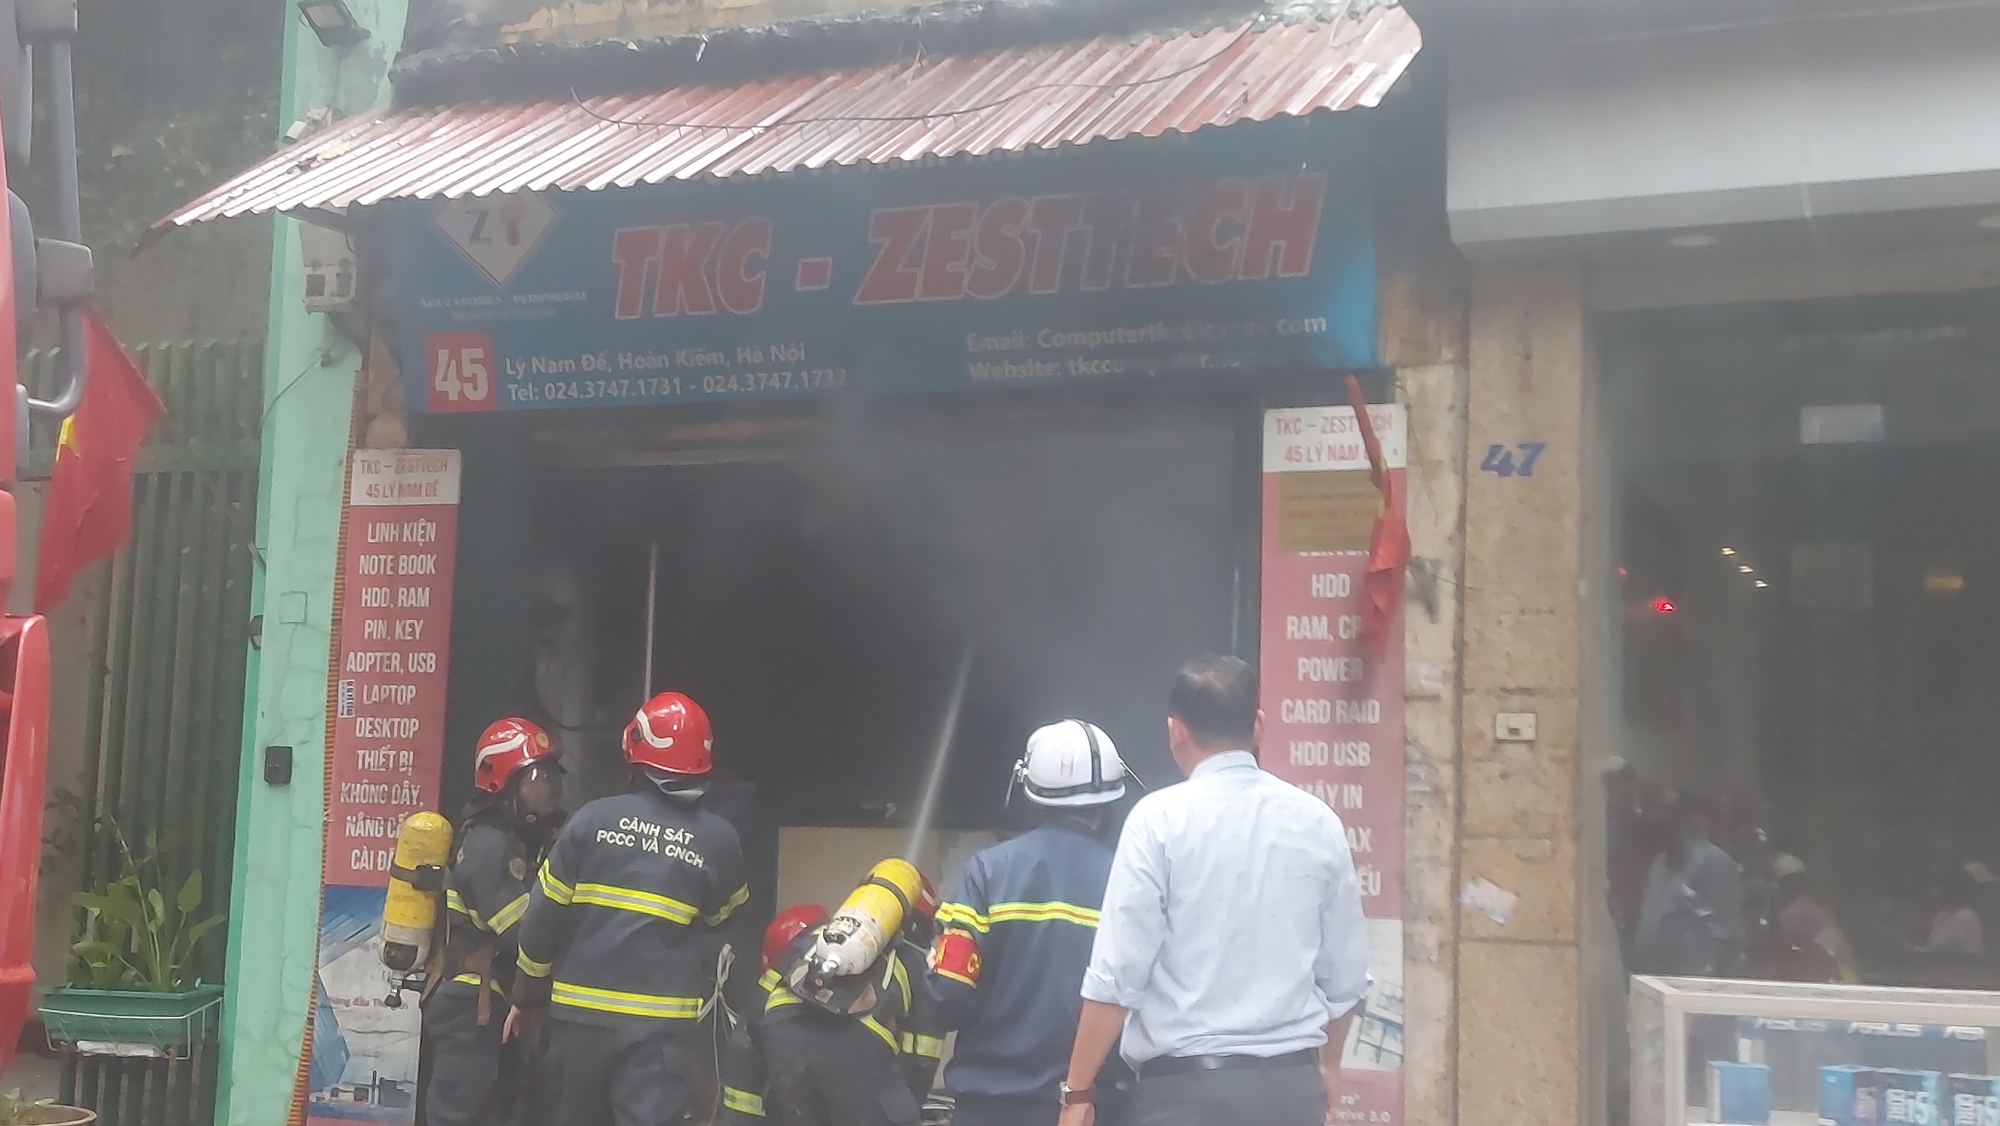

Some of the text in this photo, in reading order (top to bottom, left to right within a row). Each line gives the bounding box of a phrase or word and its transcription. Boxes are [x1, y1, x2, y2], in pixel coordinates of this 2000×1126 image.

[612, 217, 774, 319] TKC
[853, 172, 1328, 305] ZESTTECH
[434, 348, 489, 401] 45
[505, 356, 527, 380] Lý
[532, 356, 576, 375] Nam
[619, 350, 669, 371] Hoàn
[737, 345, 764, 364] Hà
[771, 342, 806, 366] Nội
[968, 358, 1061, 381] Website:
[508, 383, 539, 402] Tel:
[545, 376, 681, 401] 024.3747.1731
[1275, 417, 1302, 436] TKC
[1284, 445, 1303, 463] 45
[1328, 444, 1359, 462] NAM
[1480, 442, 1546, 478] 47
[361, 459, 381, 475] TKC
[366, 483, 380, 499] 45
[367, 517, 436, 547] LINH KIỆN
[359, 554, 437, 576] NOTE BOOK
[361, 586, 430, 610] HDD, RAM
[1312, 573, 1351, 598] HDD
[364, 619, 424, 642] PIN, KEY
[1286, 614, 1333, 642] RAM,
[346, 651, 436, 676] ADPTER, USB
[1297, 656, 1364, 682] POWER
[363, 684, 417, 705] LAPTOP
[1281, 698, 1381, 725] CARD RAID
[355, 717, 419, 739] DESKTOP
[357, 744, 414, 776] THIẾT BỊ
[1289, 741, 1371, 767] HDD USB
[340, 778, 388, 805] KHÔNG
[1343, 782, 1363, 810] IN
[596, 829, 705, 869] PCCC VÀ CNCH
[663, 828, 695, 846] SÁT
[350, 844, 375, 871] CÀI
